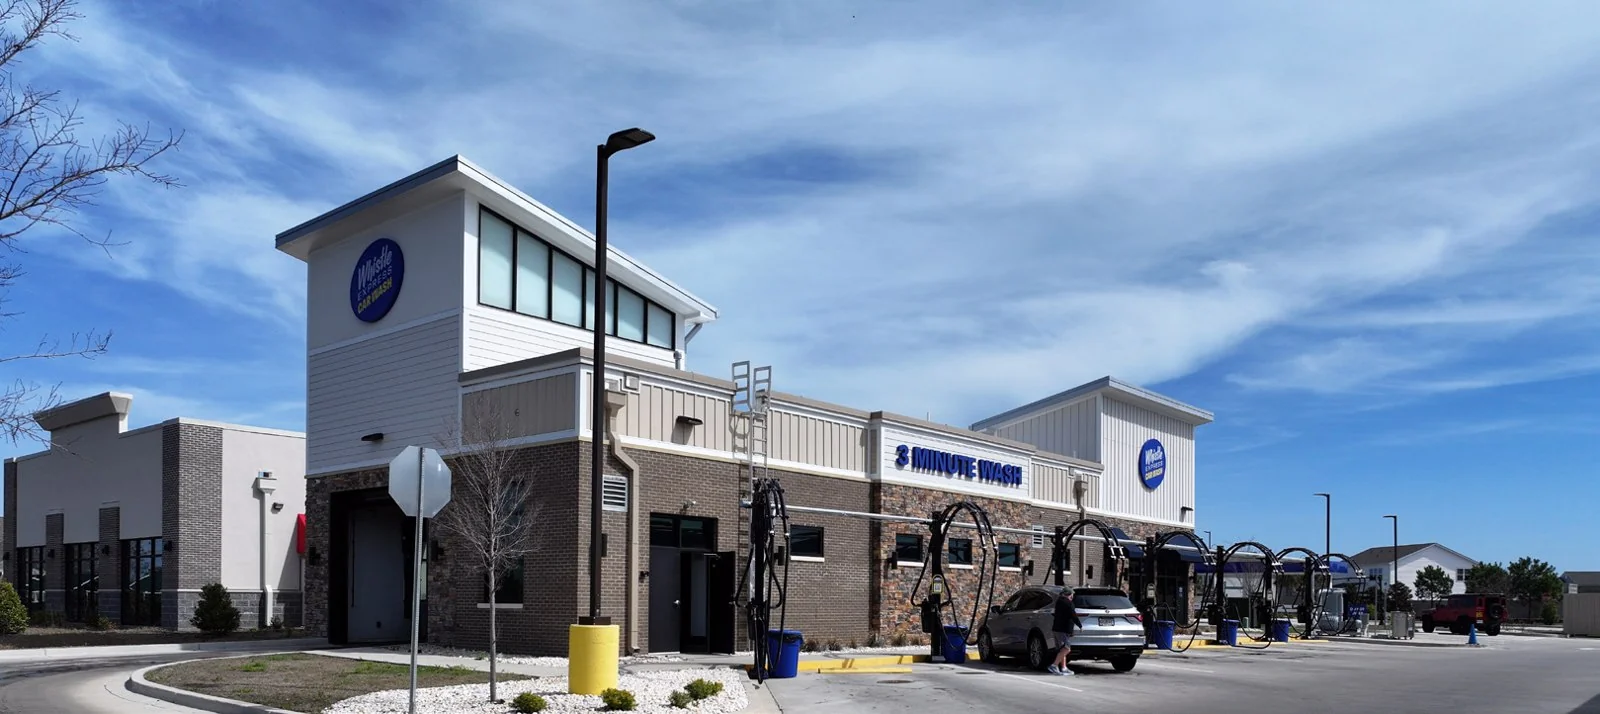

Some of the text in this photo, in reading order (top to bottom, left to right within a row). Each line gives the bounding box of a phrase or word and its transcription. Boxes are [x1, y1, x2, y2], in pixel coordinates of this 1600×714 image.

[358, 244, 393, 291] Whistle
[358, 265, 392, 302] EXPRESS
[357, 276, 392, 314] CAR WASH
[895, 444, 1023, 485] 3 MINUTE WASH
